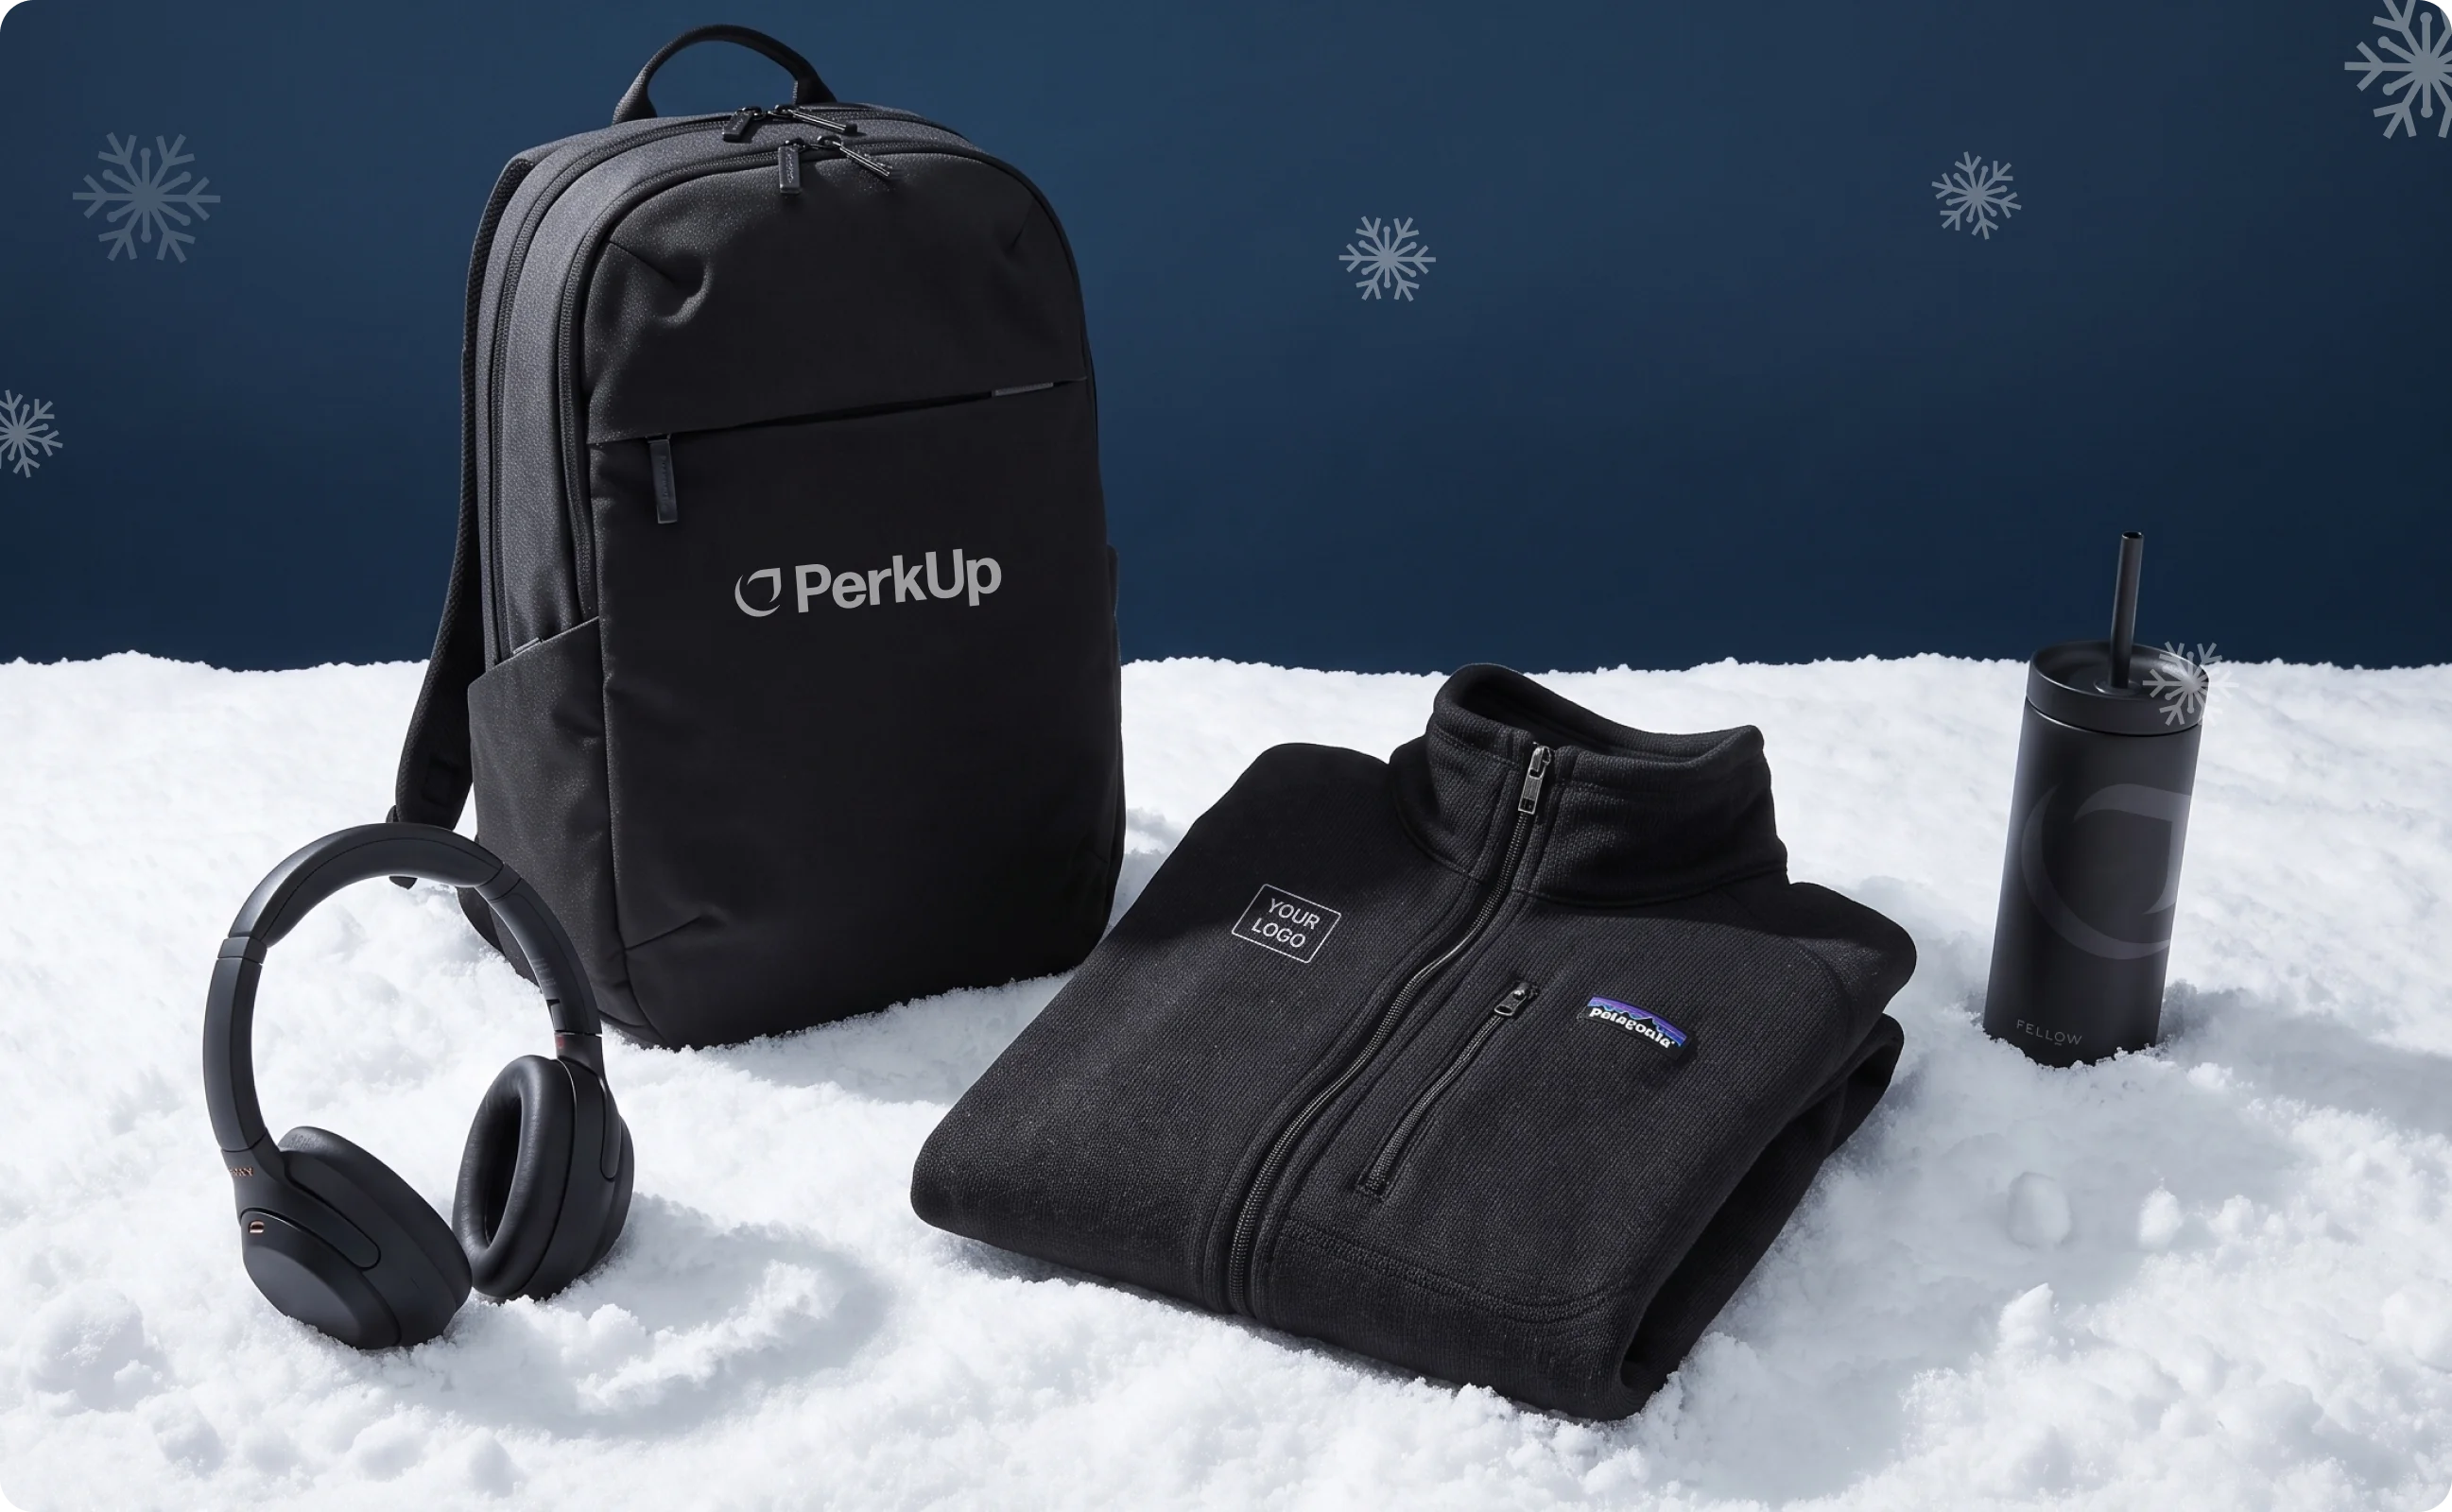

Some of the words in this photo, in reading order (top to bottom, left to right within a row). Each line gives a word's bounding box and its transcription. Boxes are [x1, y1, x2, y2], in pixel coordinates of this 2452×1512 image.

[795, 548, 1002, 613] PerkUp
[1269, 898, 1321, 930] YOUR
[1251, 917, 1306, 948] LOGO
[2016, 1019, 2082, 1046] FELLOW
